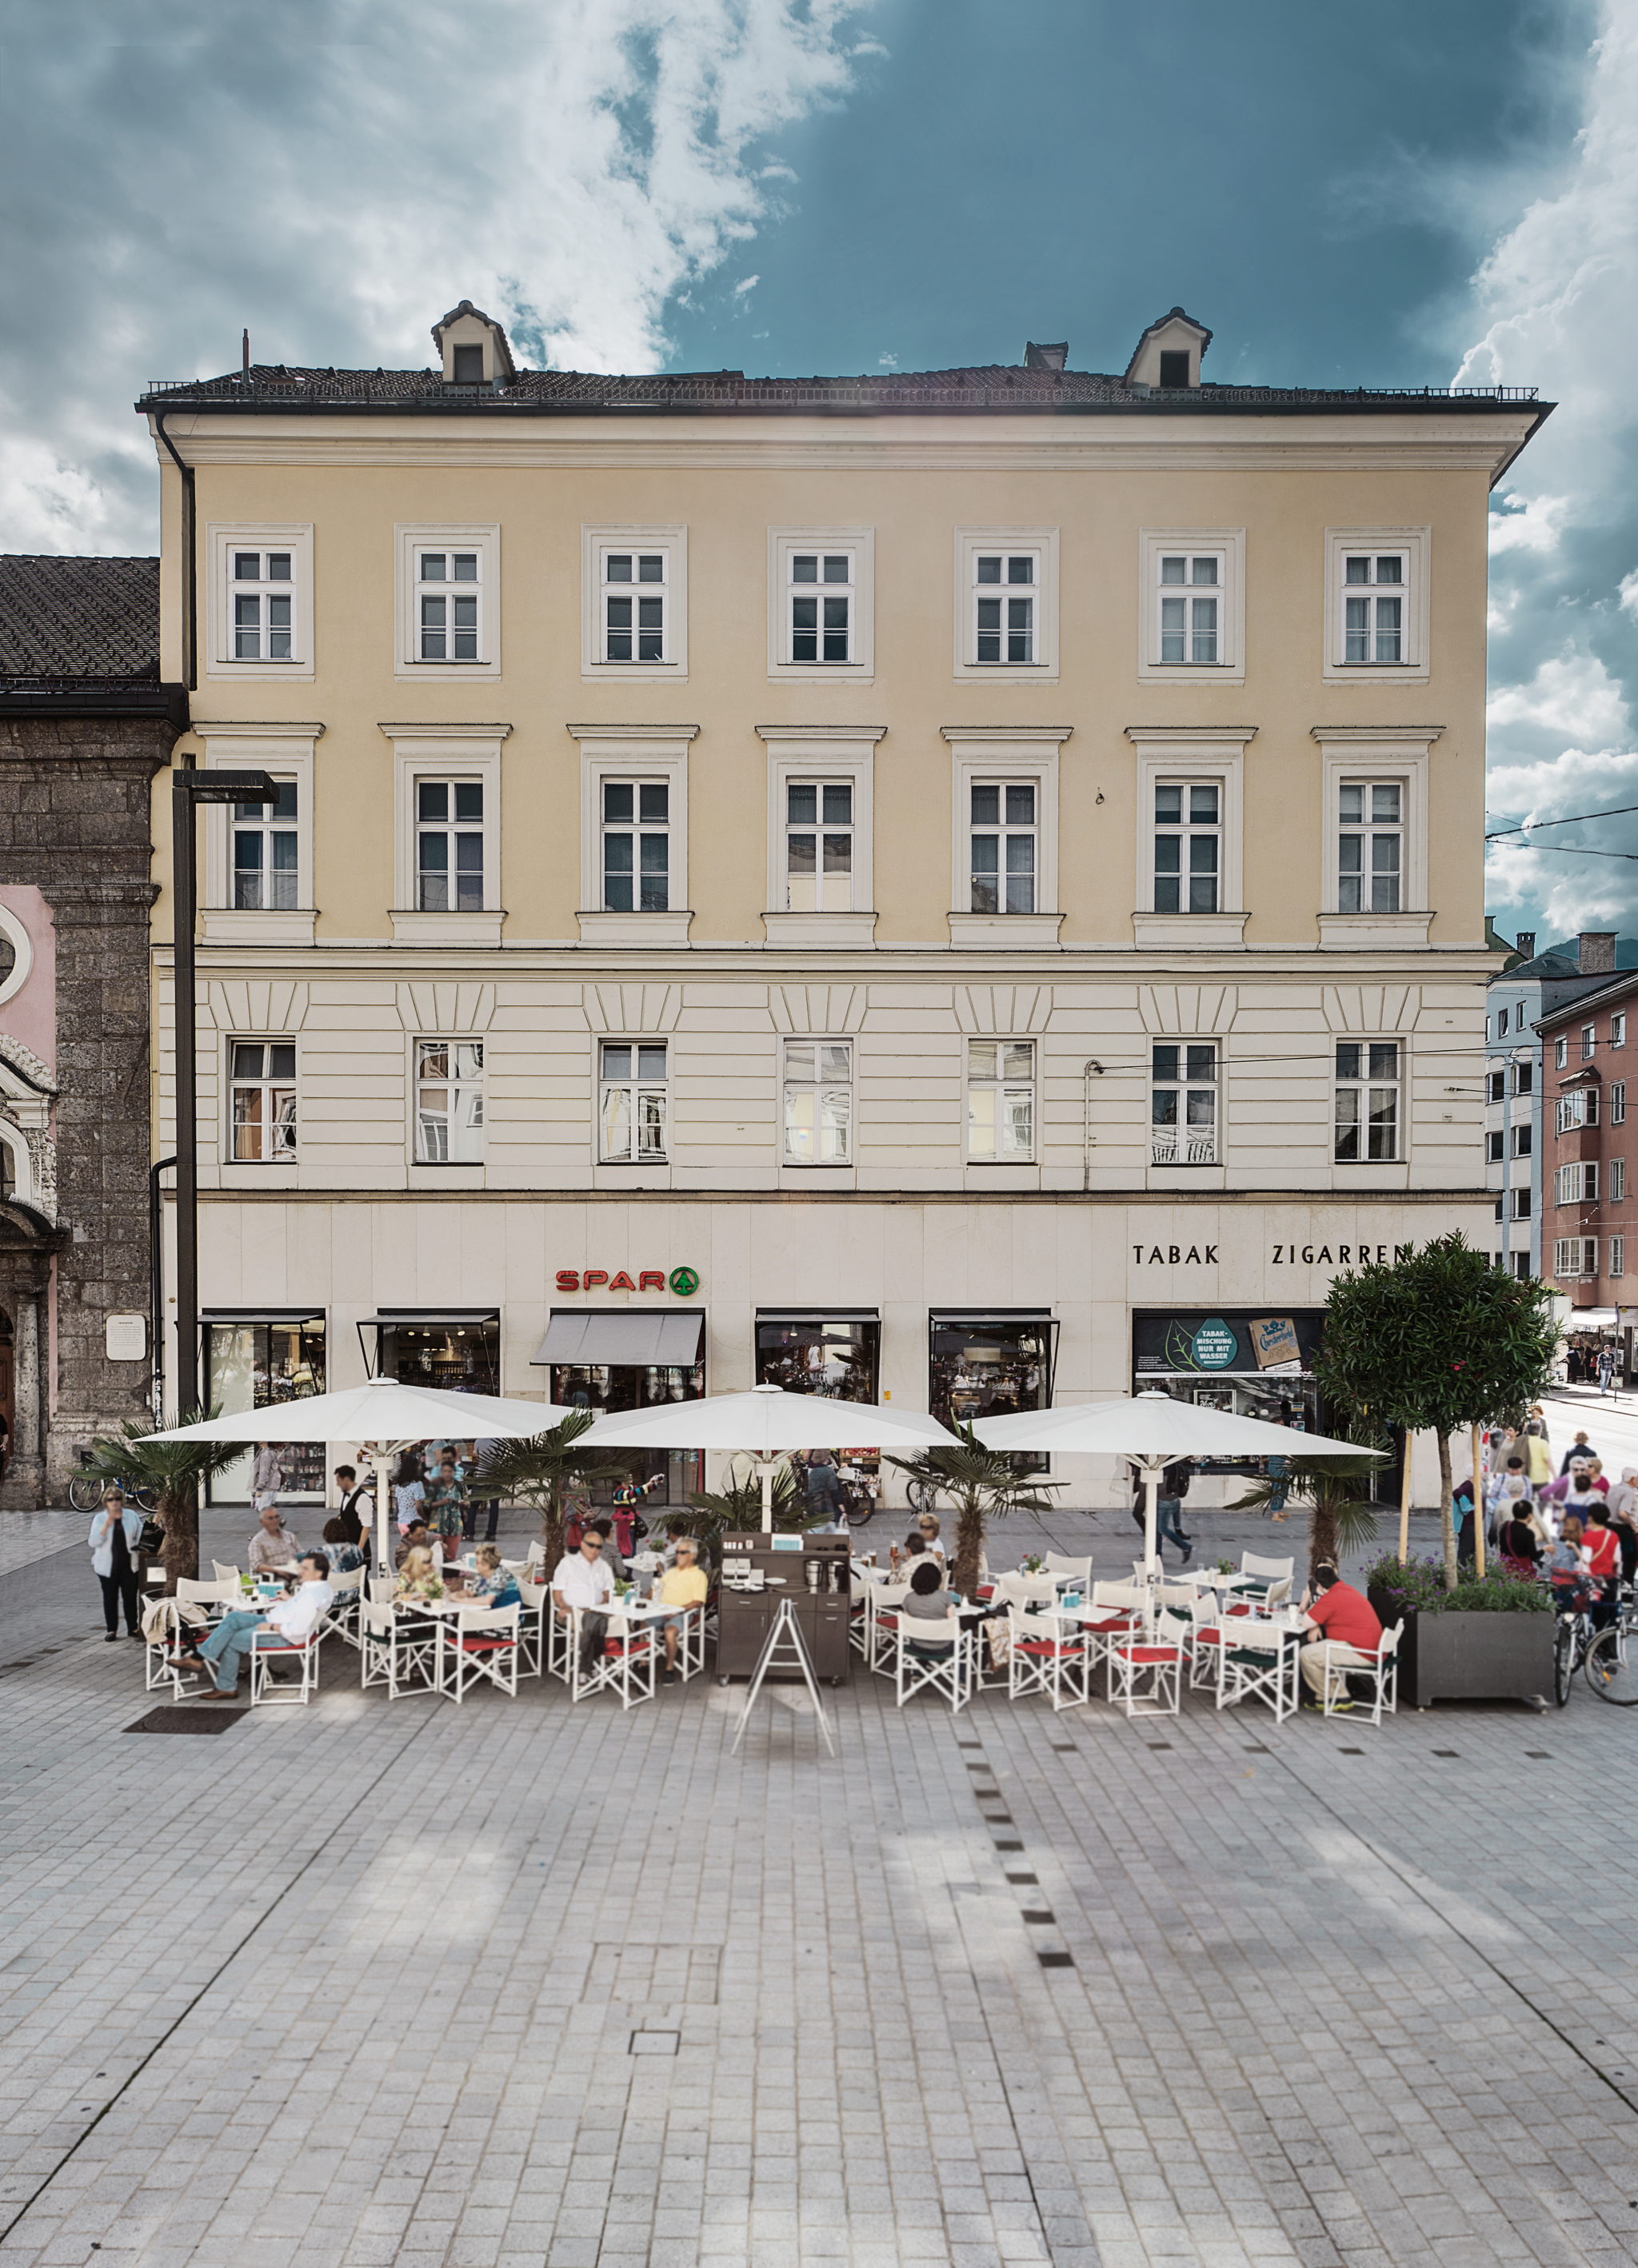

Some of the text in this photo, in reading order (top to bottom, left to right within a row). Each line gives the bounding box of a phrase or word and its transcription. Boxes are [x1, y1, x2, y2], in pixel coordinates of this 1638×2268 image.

[1133, 1244, 1408, 1264] TABAK ZIGARREN
[556, 1270, 665, 1291] SPAR
